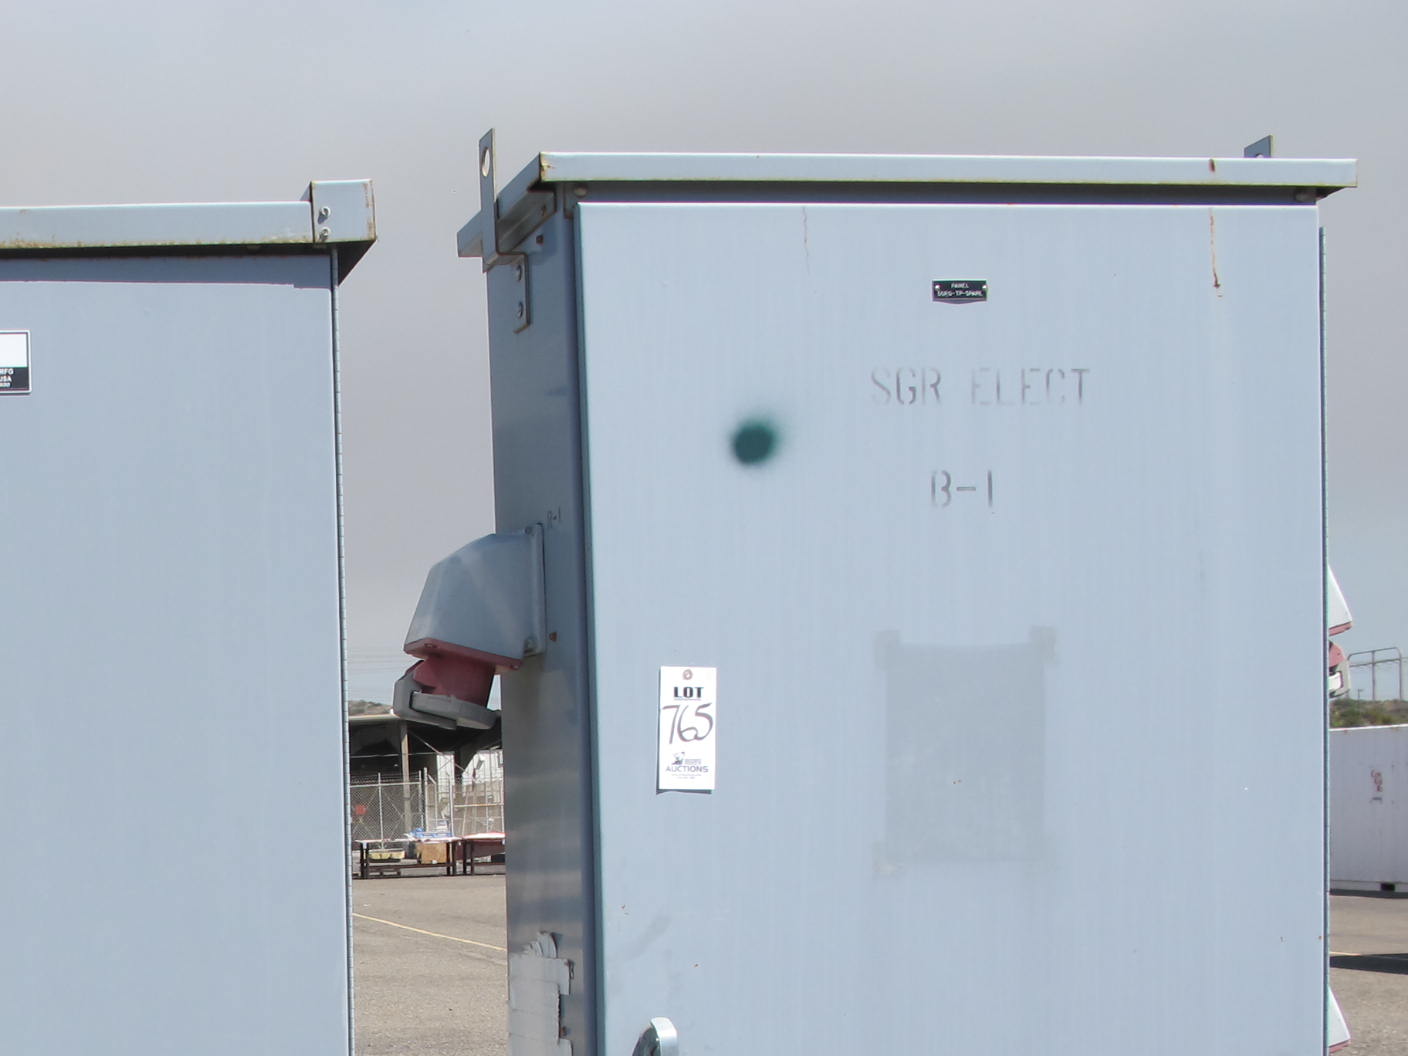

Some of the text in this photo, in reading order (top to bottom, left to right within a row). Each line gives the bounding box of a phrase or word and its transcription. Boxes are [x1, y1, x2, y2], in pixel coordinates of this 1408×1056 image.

[871, 366, 1090, 405] SGR ELECT
[931, 469, 993, 508] B-1
[674, 686, 705, 698] LOT
[662, 702, 713, 744] 765
[665, 765, 709, 773] AUCTIONS
